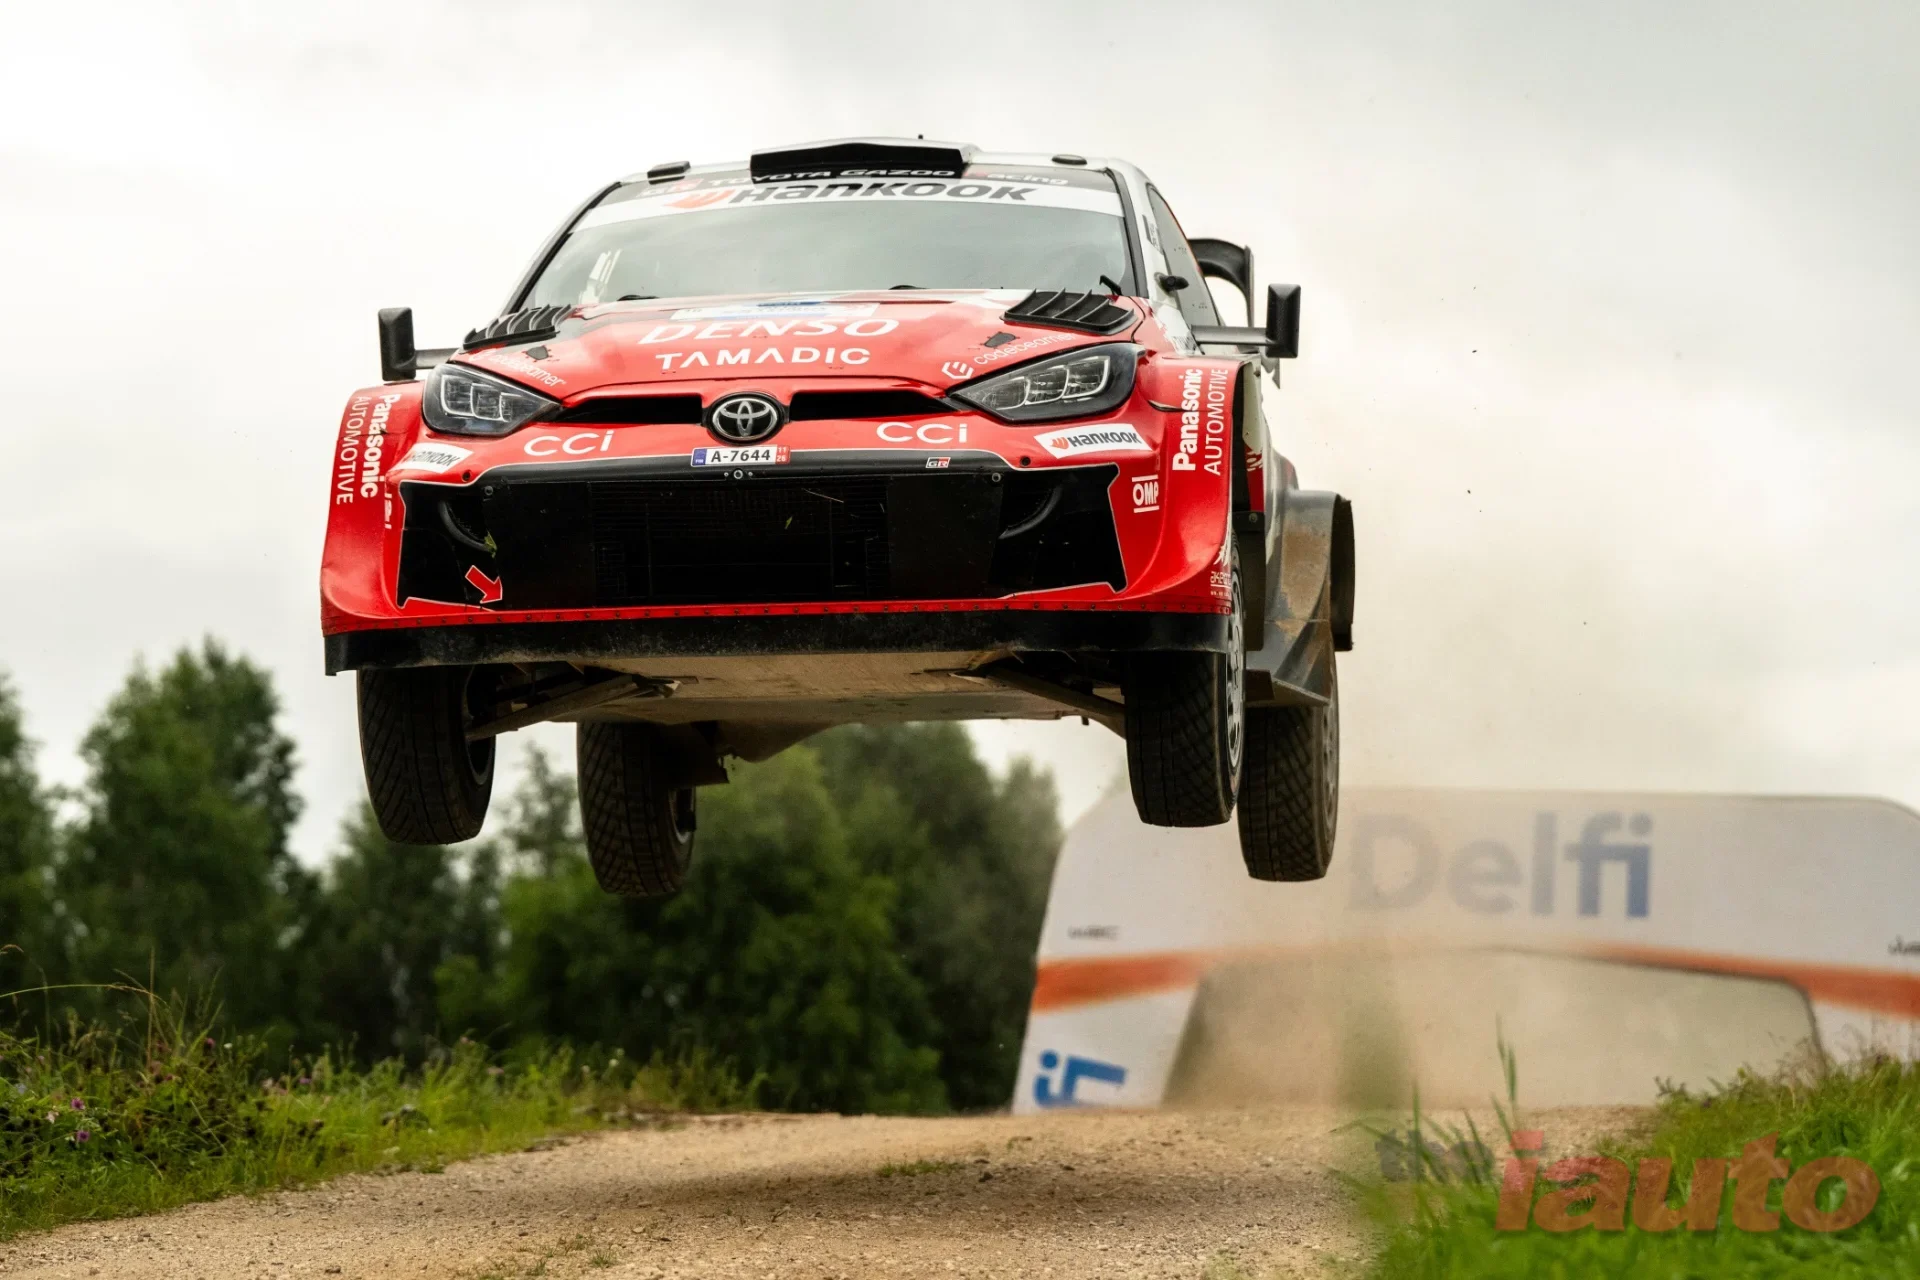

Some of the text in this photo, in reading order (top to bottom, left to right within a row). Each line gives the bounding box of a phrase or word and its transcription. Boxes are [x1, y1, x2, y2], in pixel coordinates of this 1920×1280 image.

[839, 169, 955, 177] GAZOO
[638, 319, 899, 344] DENSO
[655, 347, 871, 370] TAMADIC
[336, 396, 372, 505] AUTOMOTIVE
[360, 393, 402, 498] Panasonic
[1172, 368, 1203, 471] Panasonic
[1204, 368, 1229, 476] AUTOMOTIVE
[711, 449, 771, 463] A-7644
[1132, 481, 1160, 506] OMP
[1347, 811, 1652, 918] Delfi
